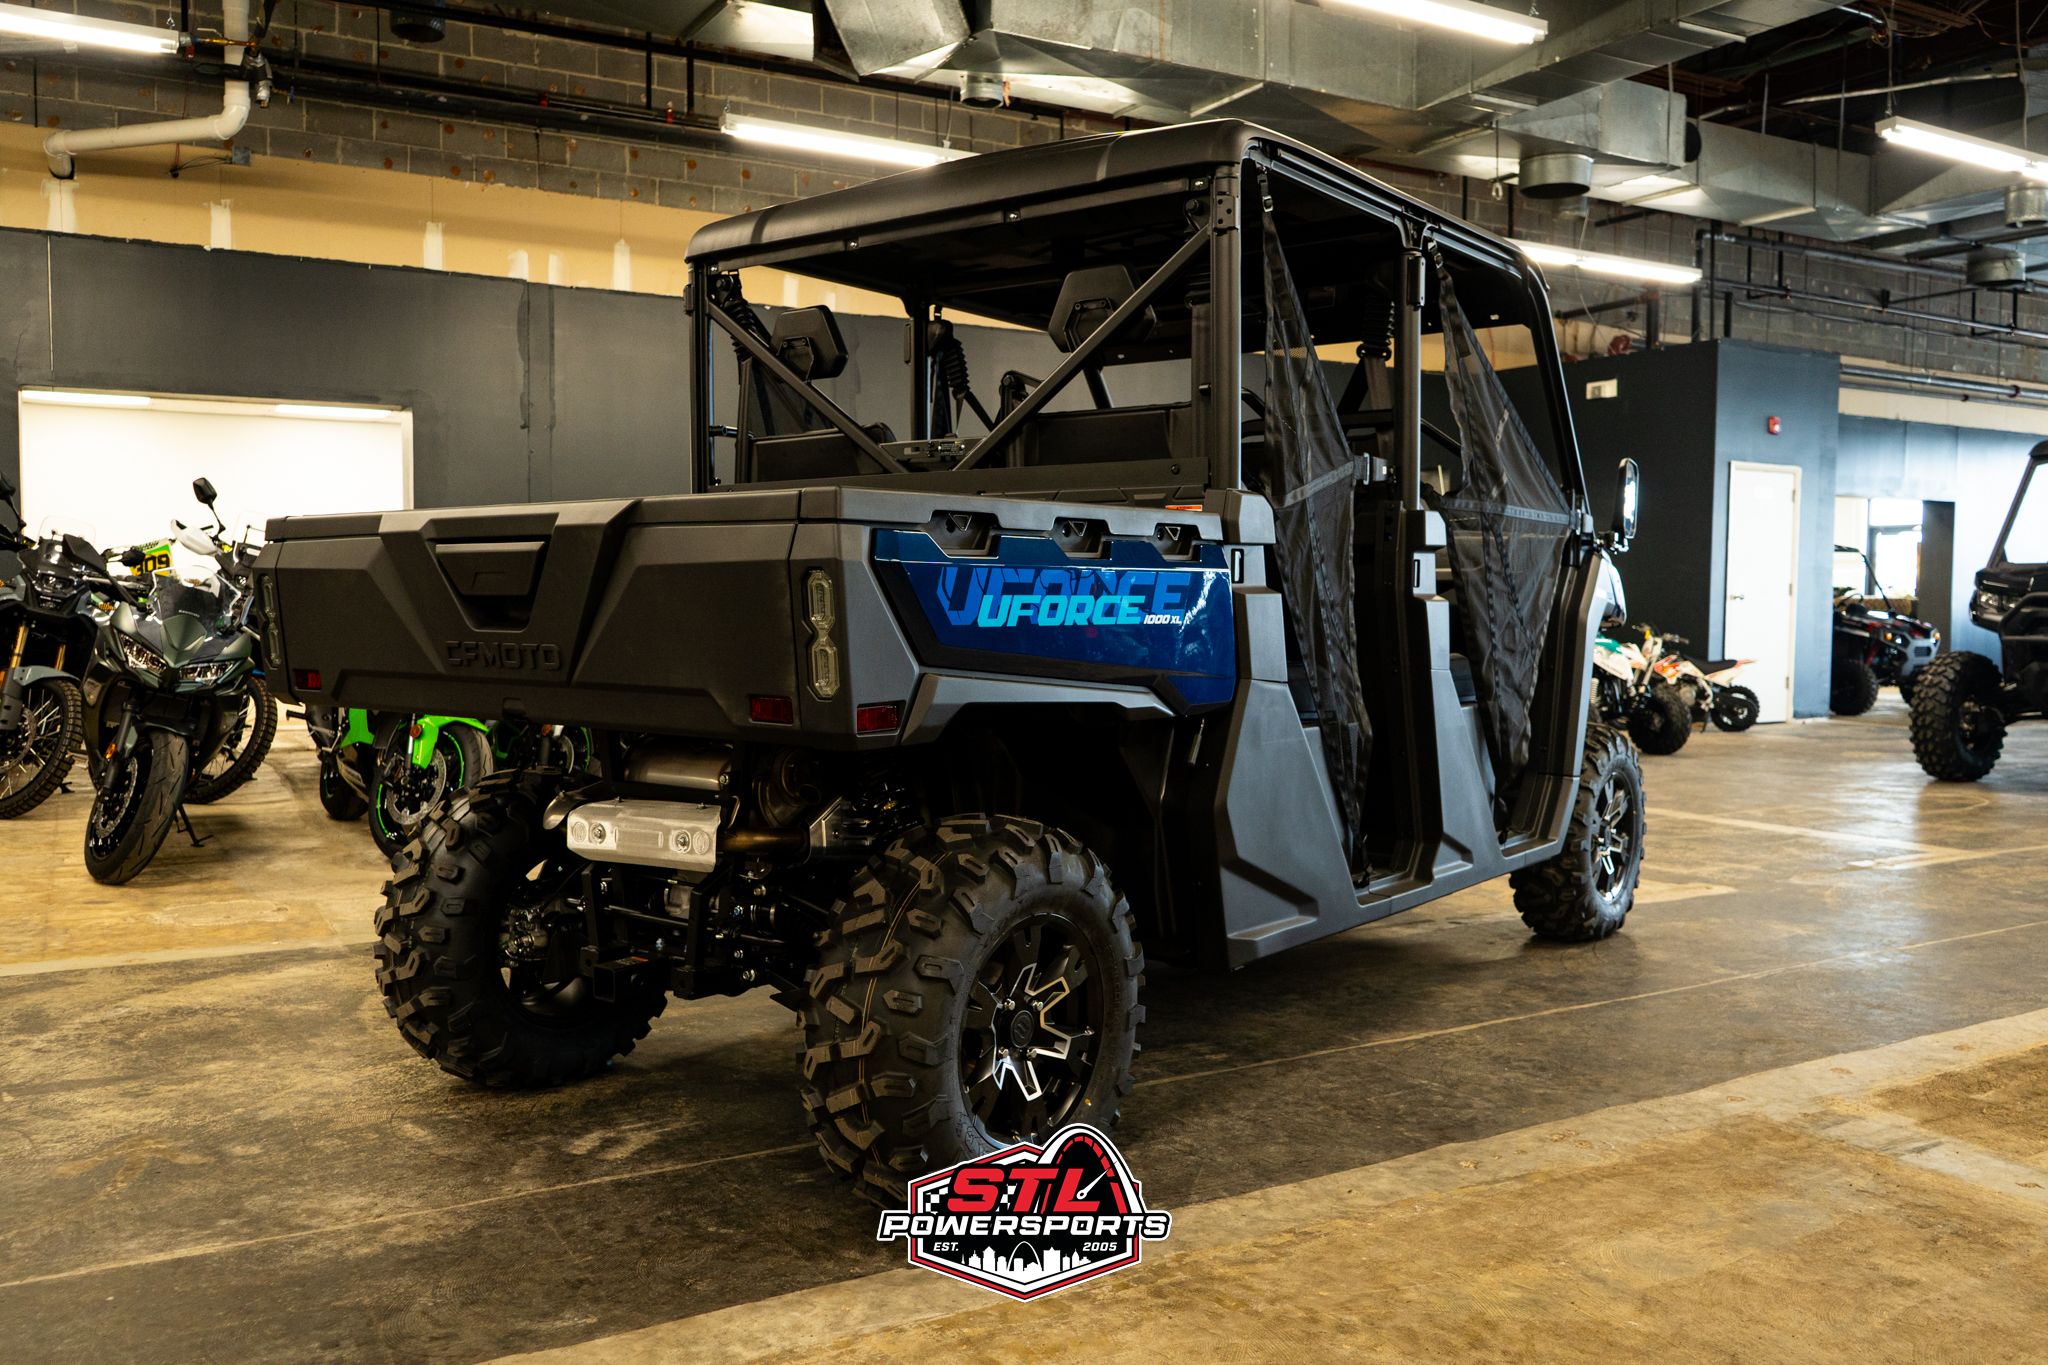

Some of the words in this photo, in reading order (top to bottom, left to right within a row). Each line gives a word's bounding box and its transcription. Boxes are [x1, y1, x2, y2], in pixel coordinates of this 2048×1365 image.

[977, 594, 1145, 627] UFORCE
[1143, 614, 1171, 625] 1000
[1170, 616, 1183, 625] XL
[445, 641, 560, 670] CFMOTO
